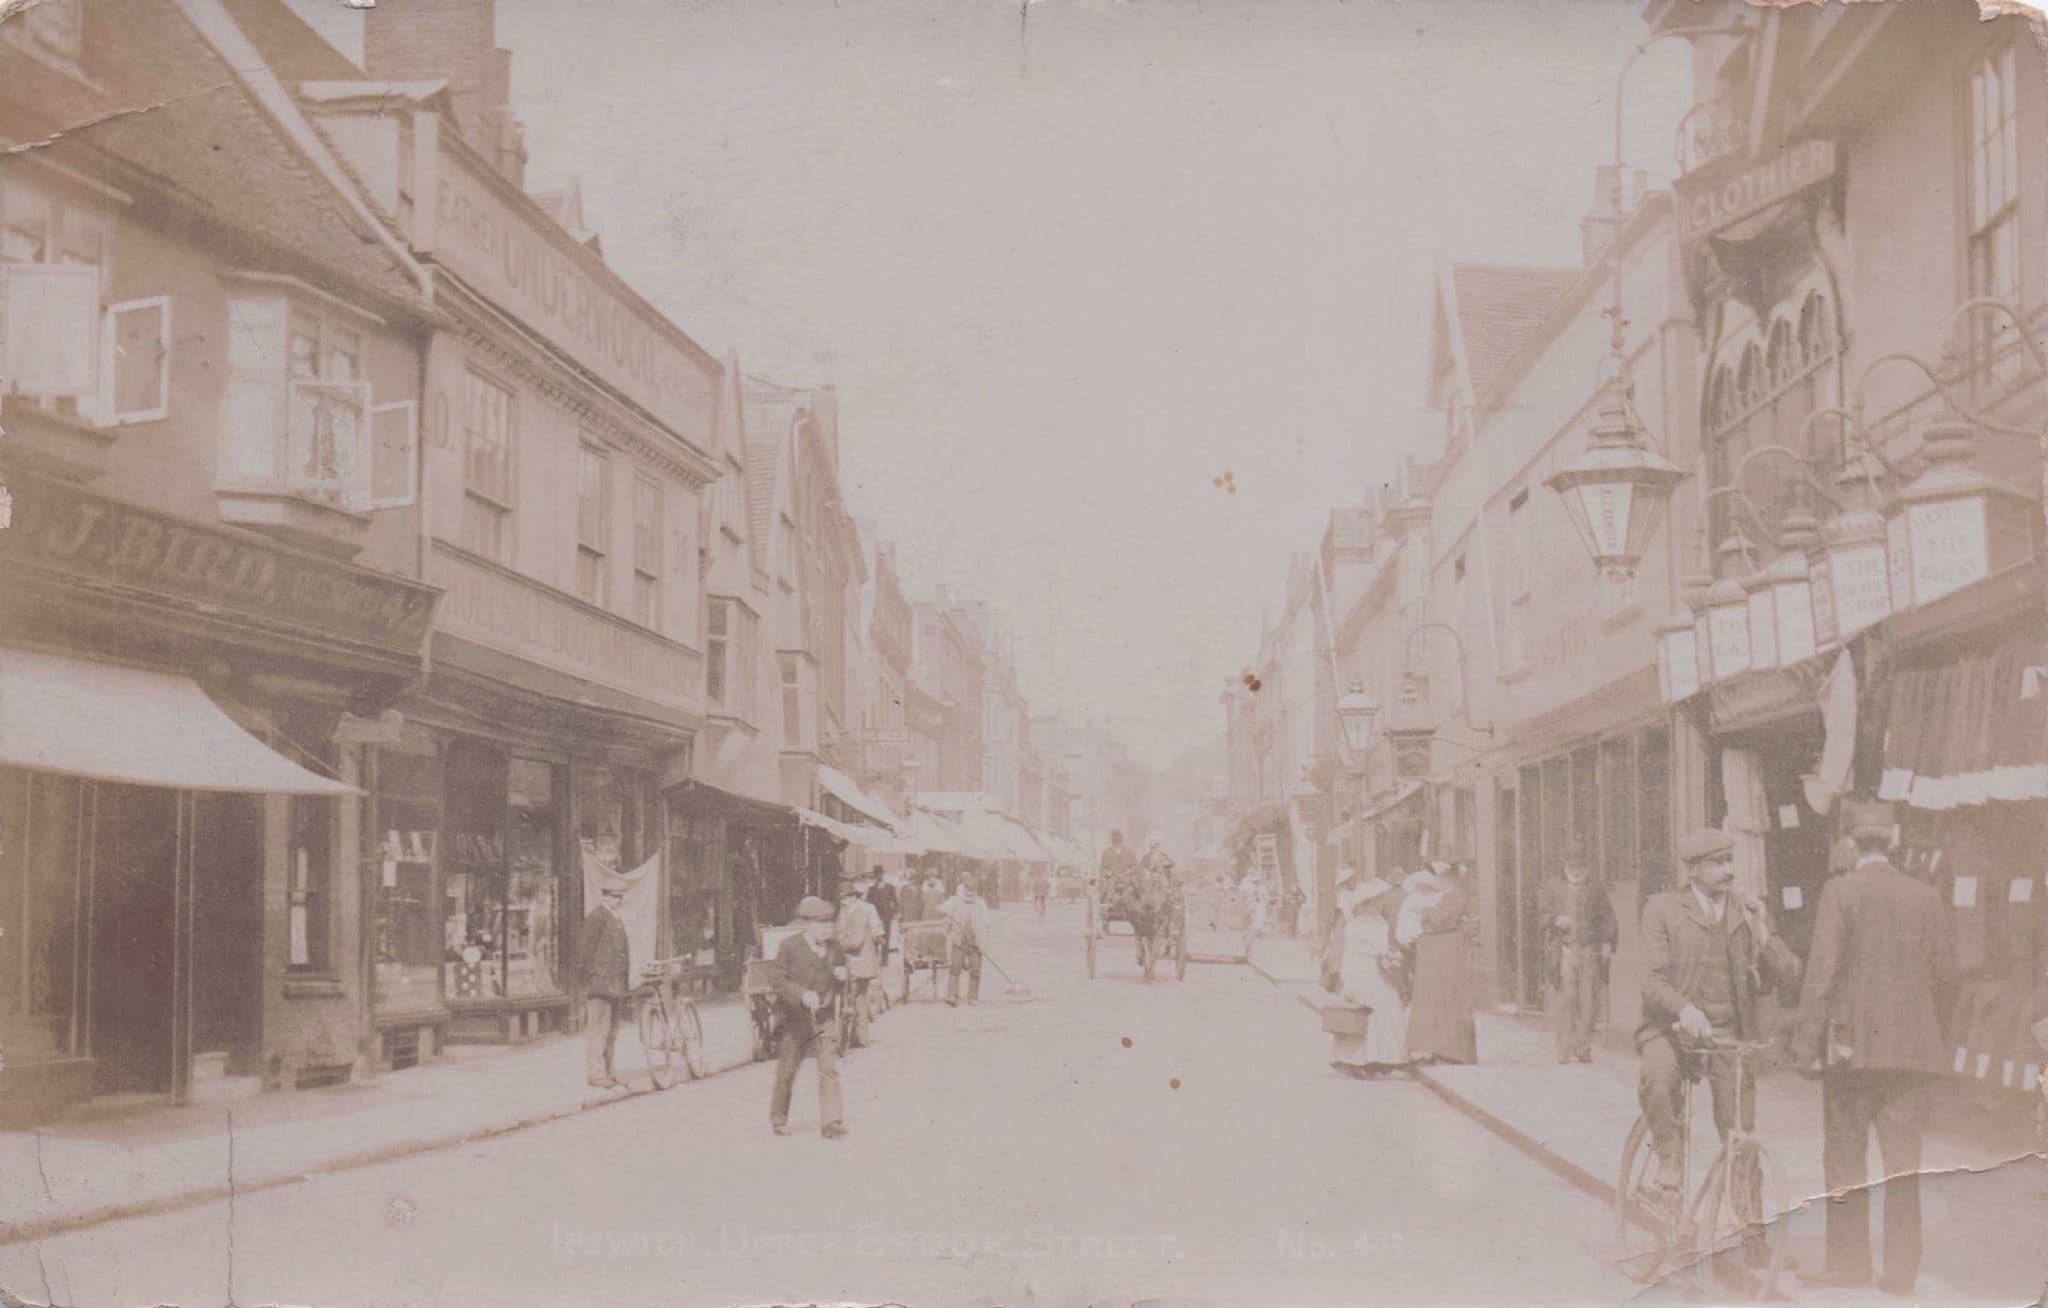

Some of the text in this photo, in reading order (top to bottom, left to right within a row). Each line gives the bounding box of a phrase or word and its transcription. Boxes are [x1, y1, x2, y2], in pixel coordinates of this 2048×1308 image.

[1692, 140, 1836, 227] CLOTHIER
[1926, 533, 1972, 557] THE
[1843, 558, 1879, 577] THE
